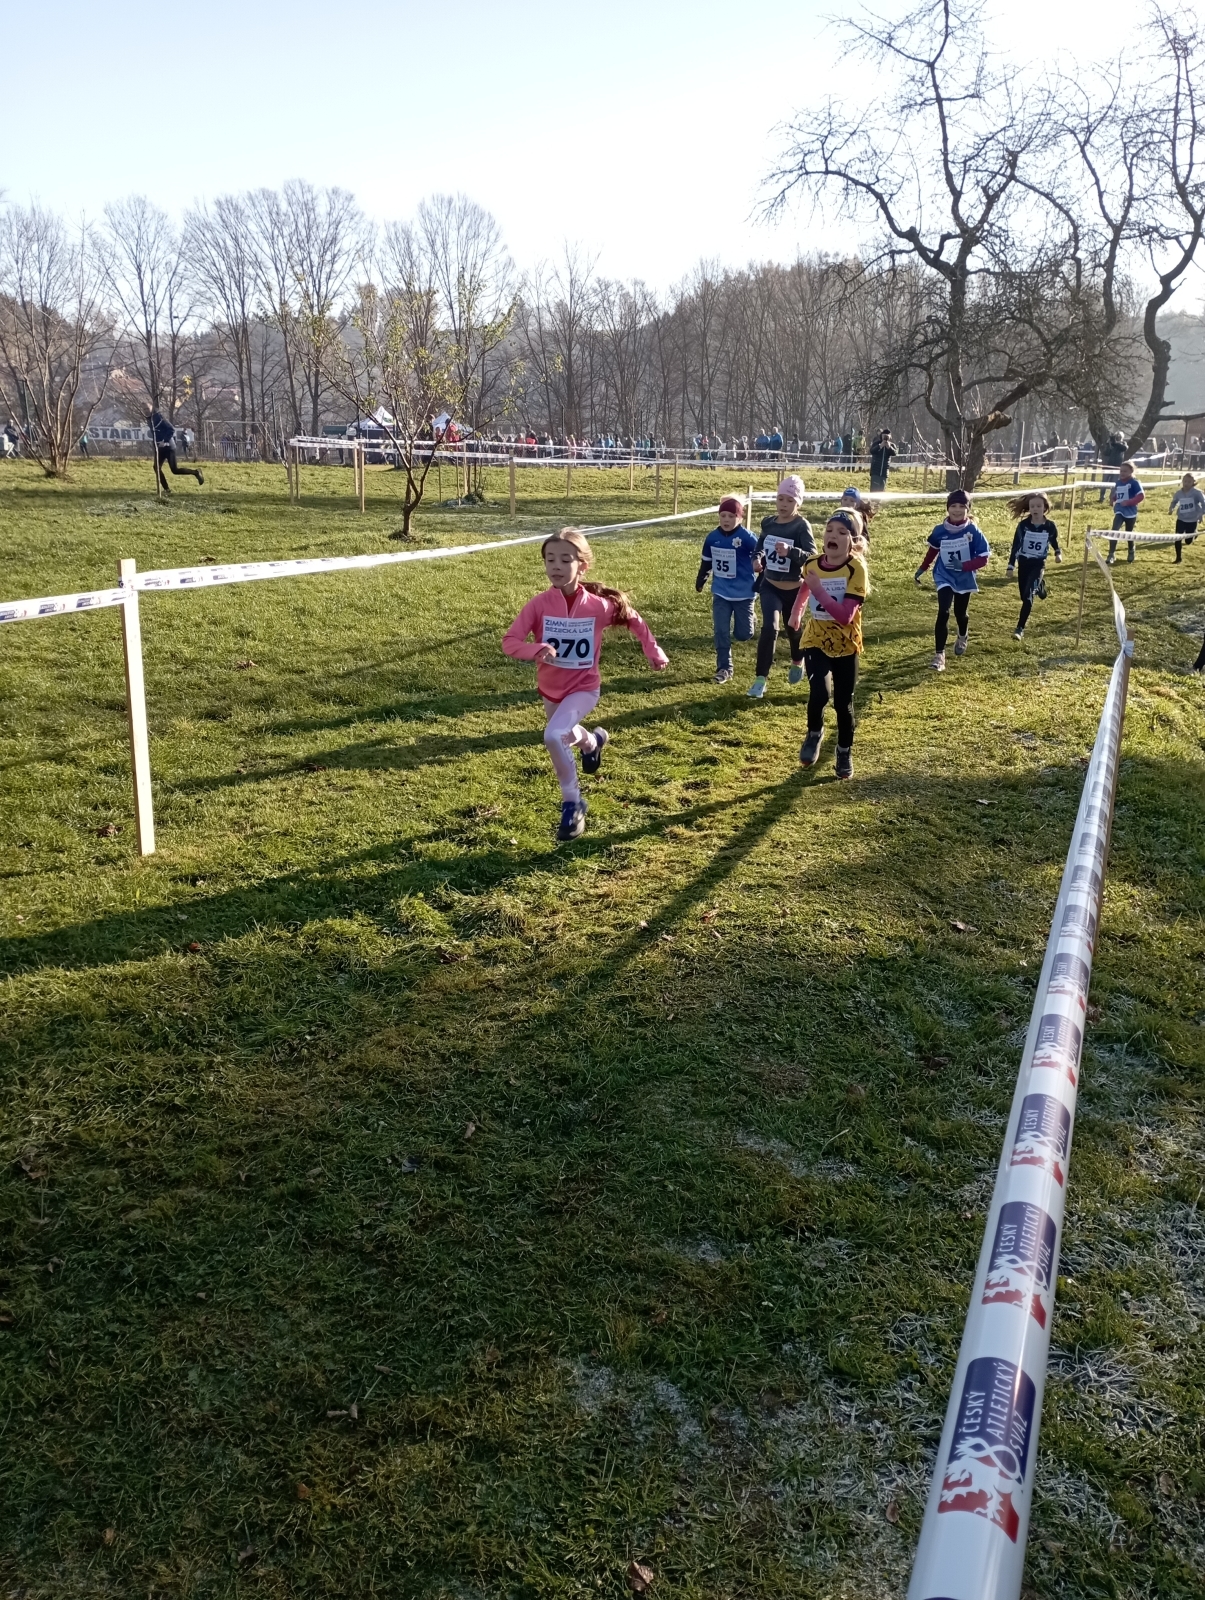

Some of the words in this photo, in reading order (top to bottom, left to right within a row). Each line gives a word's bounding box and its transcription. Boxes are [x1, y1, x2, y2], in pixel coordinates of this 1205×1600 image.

[88, 427, 141, 440] START
[947, 550, 962, 562] 31
[1027, 540, 1042, 551] 36
[715, 559, 730, 573] 35
[546, 637, 590, 659] 270
[996, 1224, 1018, 1252] ČESKÝ
[1019, 1204, 1040, 1259] ATLETICKÝ
[1038, 1239, 1051, 1272] SVAZ
[958, 1391, 986, 1434] ČESKÝ
[986, 1362, 1014, 1441] ATLETICKÝ
[1009, 1409, 1028, 1457] SVAZ
